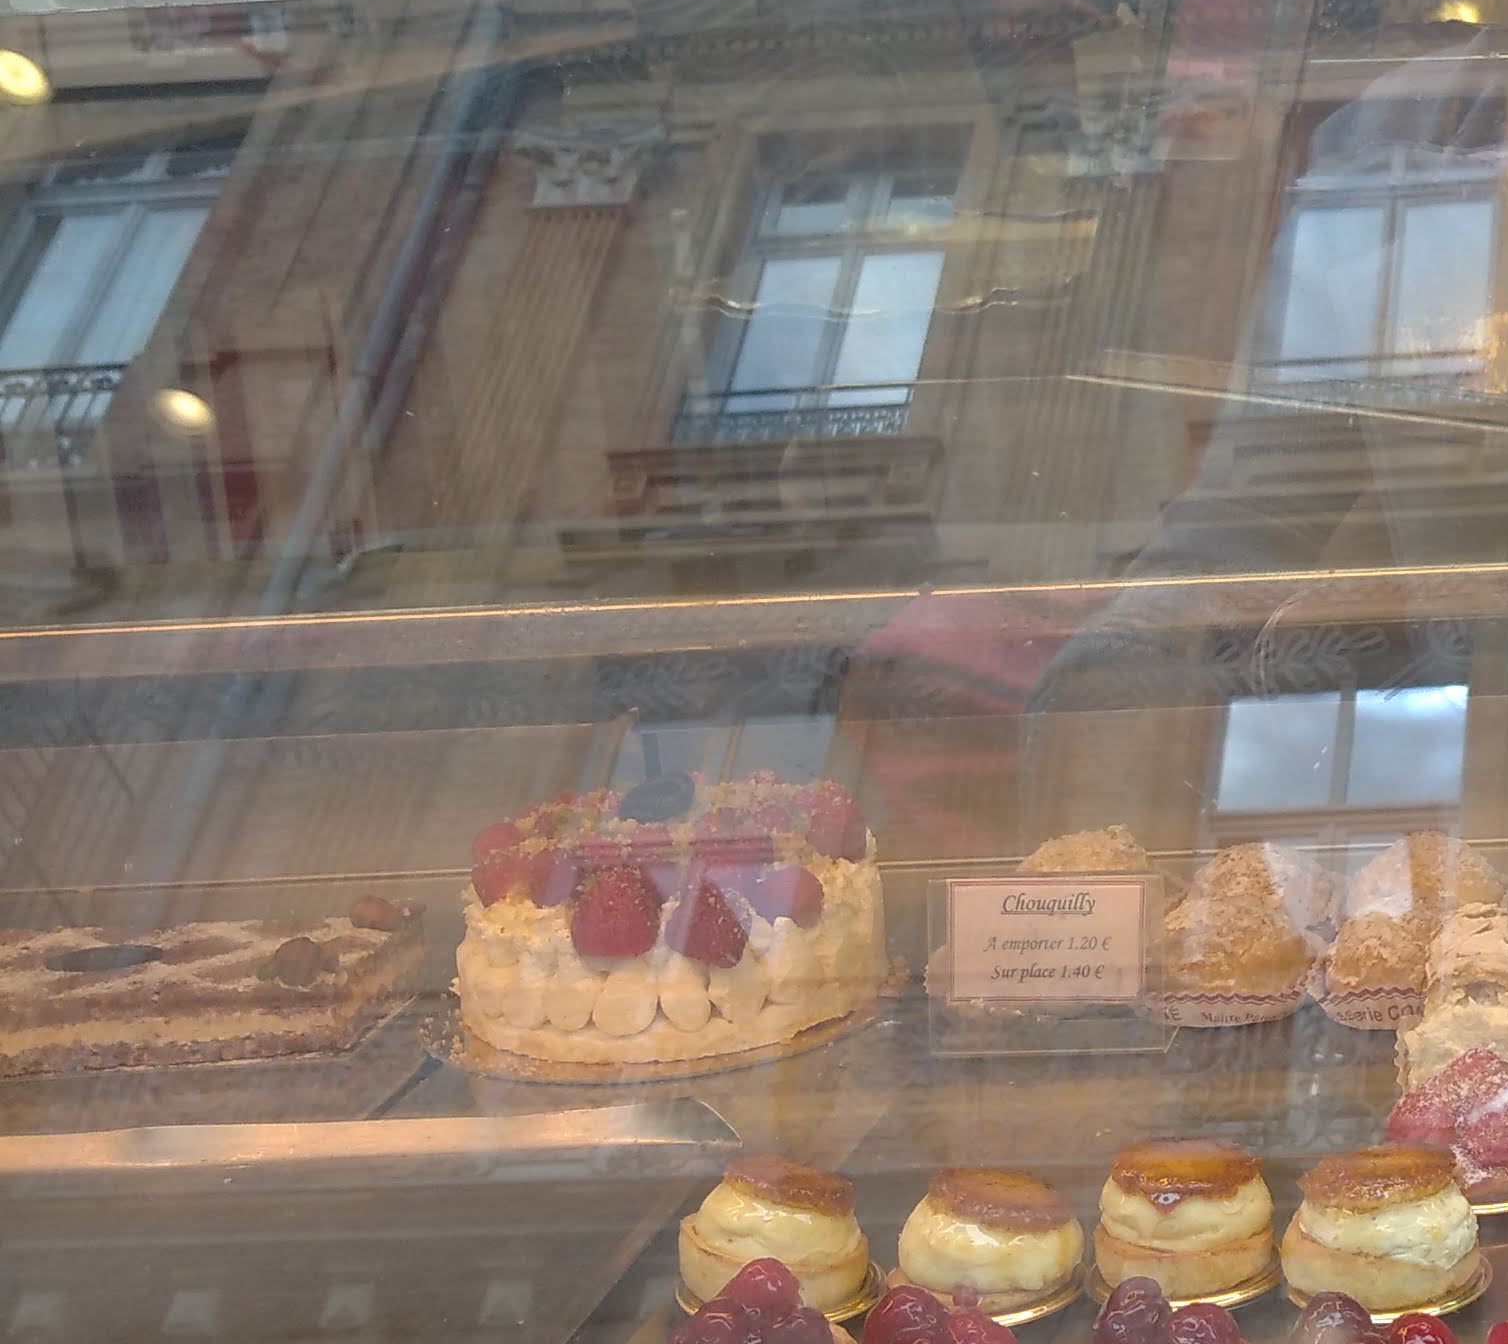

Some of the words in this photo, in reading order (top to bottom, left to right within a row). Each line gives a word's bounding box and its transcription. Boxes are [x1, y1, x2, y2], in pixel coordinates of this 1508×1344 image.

[1001, 892, 1096, 917] Chouquilly
[982, 936, 998, 953] A
[1001, 938, 1065, 955] emporter
[1067, 936, 1098, 950] 1.20
[1101, 936, 1113, 951] €
[990, 964, 1018, 980] Sur
[1019, 962, 1056, 983] place
[1060, 963, 1091, 979] 1.40
[1094, 964, 1105, 980] €
